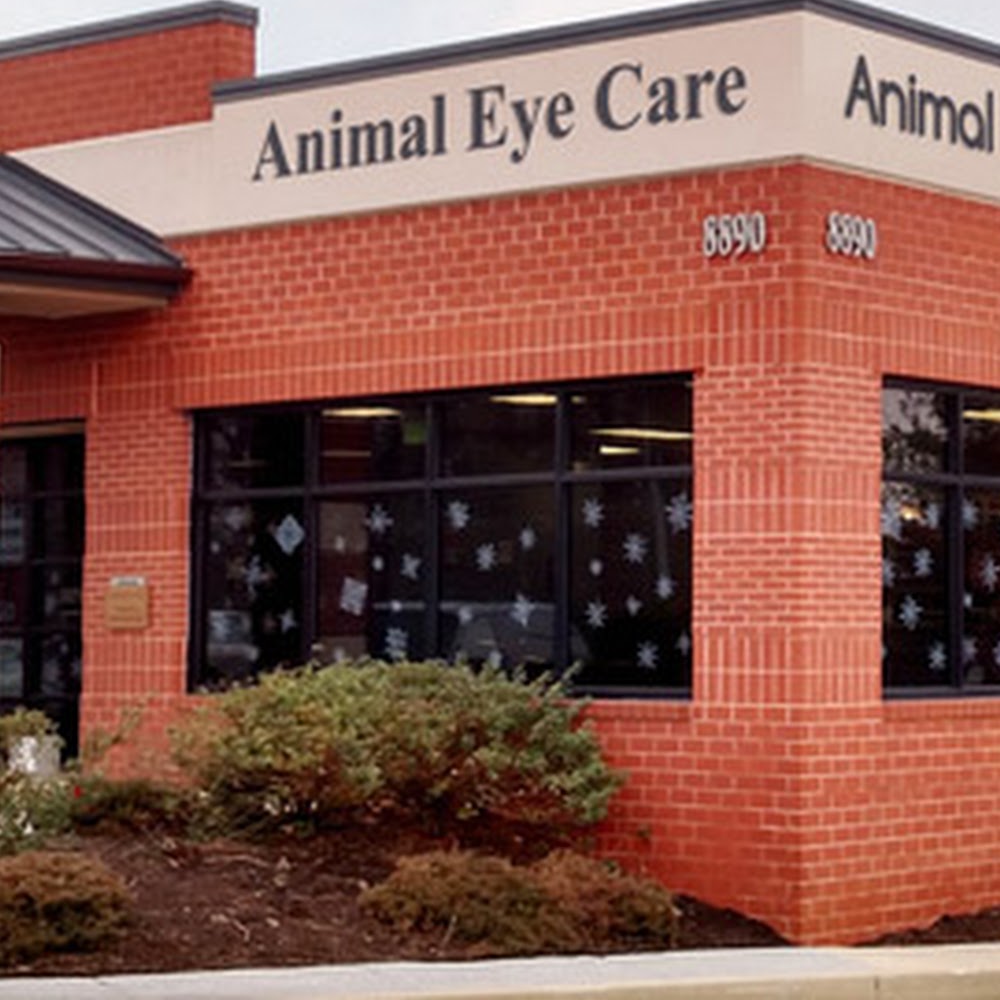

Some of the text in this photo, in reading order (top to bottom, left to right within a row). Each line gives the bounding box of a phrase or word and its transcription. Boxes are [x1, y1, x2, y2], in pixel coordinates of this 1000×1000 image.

[251, 63, 747, 182] Animal Eye Care
[844, 54, 994, 154] Animal
[703, 210, 766, 257] 8890
